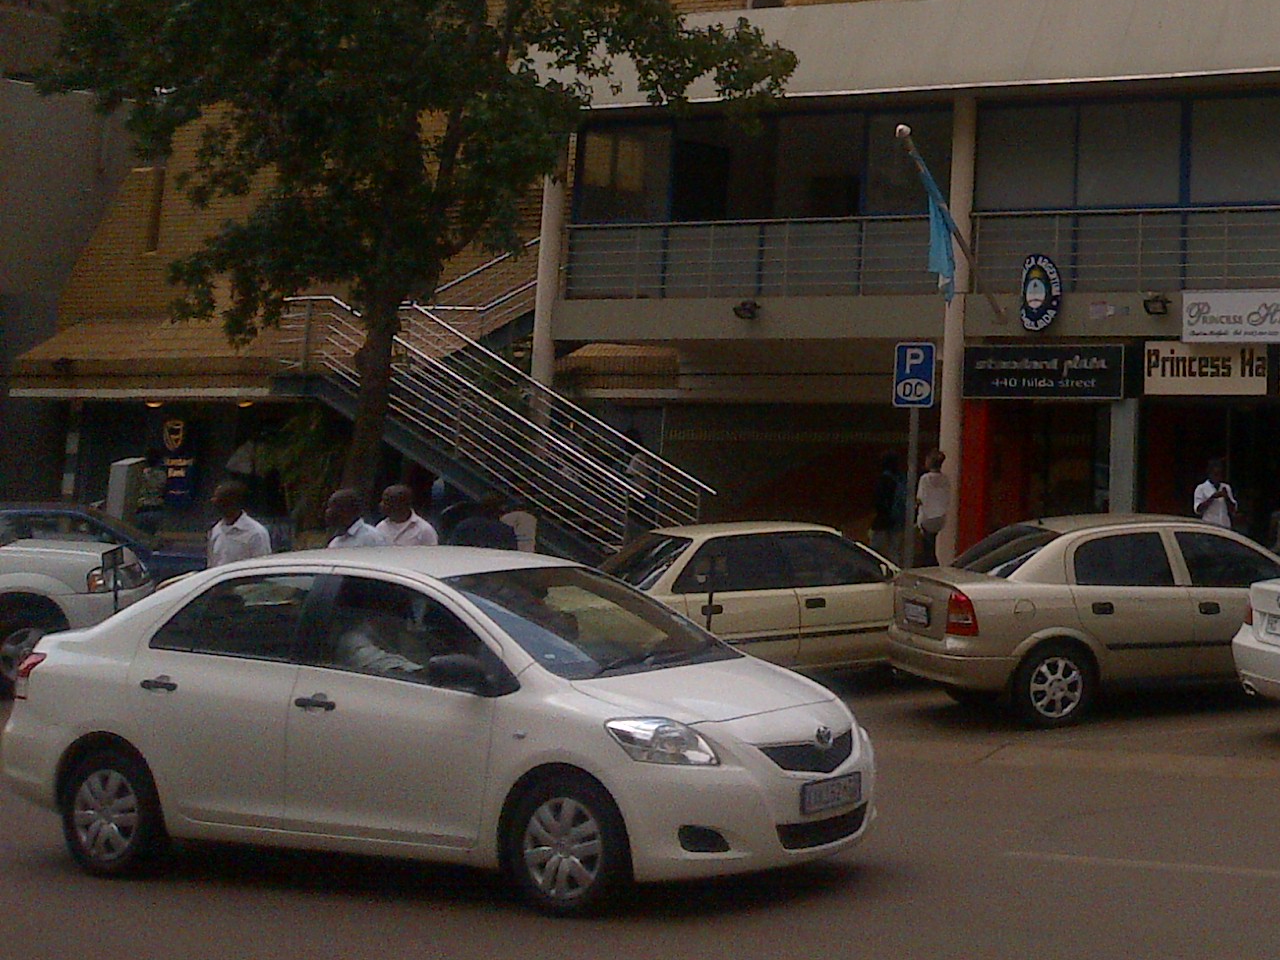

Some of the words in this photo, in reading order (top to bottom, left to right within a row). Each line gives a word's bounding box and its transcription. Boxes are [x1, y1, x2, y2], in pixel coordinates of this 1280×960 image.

[905, 348, 925, 374] P
[1146, 348, 1232, 377] Princess
[903, 382, 925, 398] DC
